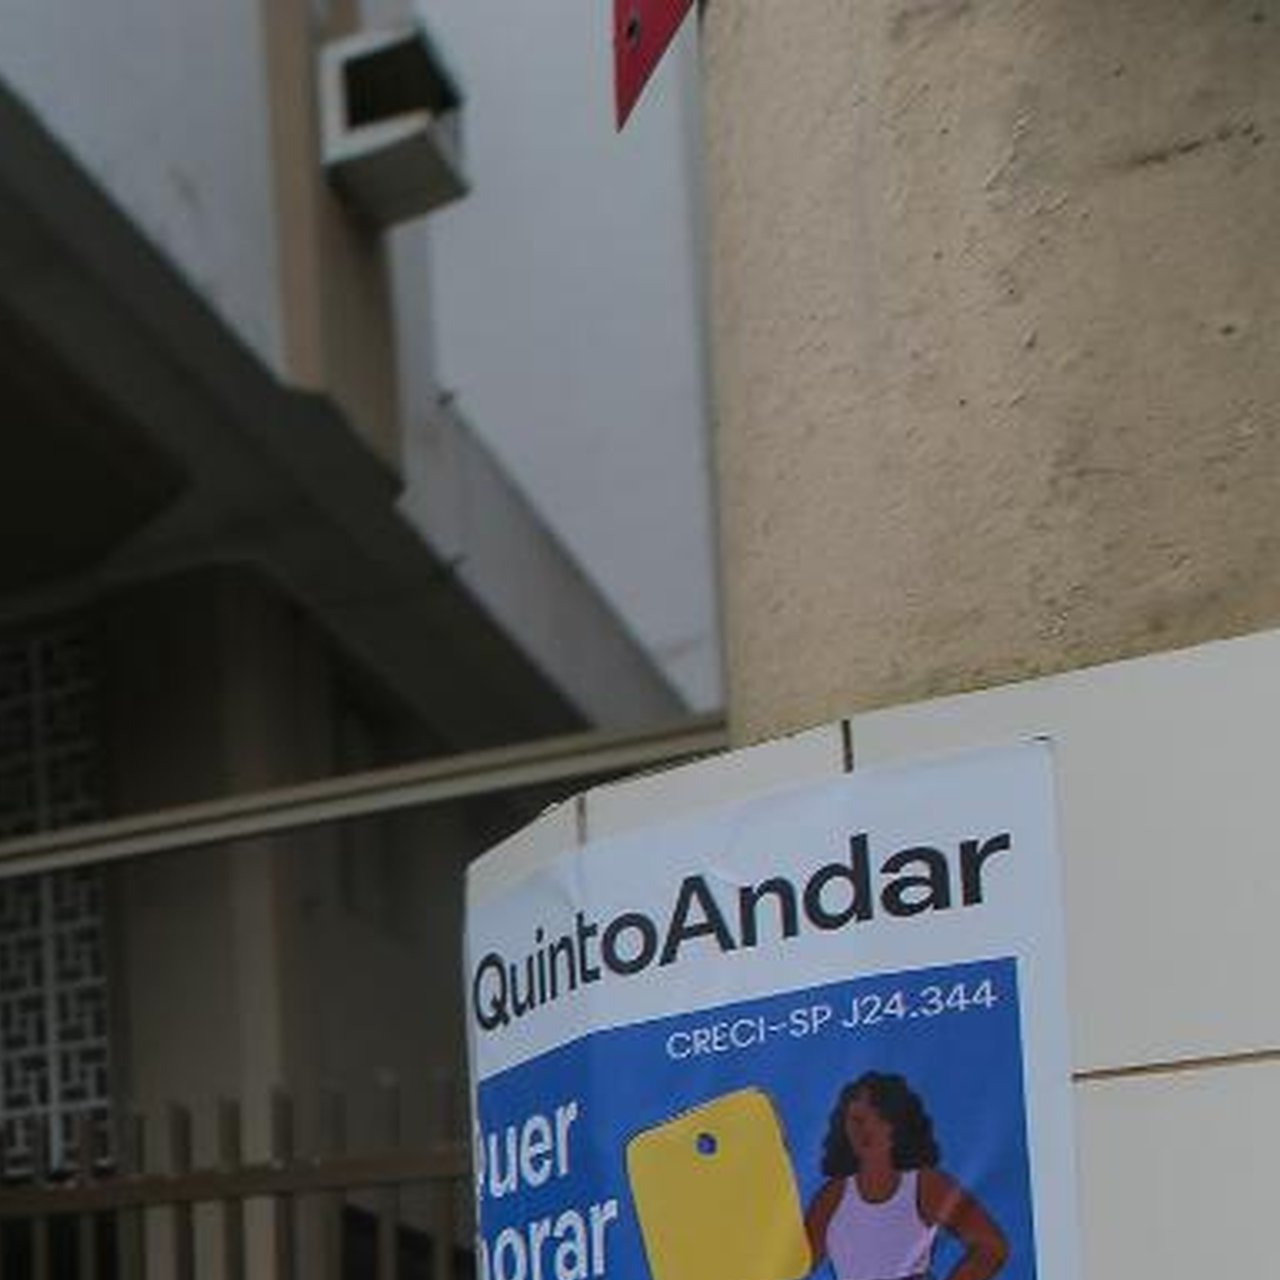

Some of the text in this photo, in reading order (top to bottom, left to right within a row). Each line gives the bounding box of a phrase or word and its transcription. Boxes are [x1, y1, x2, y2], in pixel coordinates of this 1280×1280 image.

[472, 833, 1011, 1032] QuintoAndar
[666, 979, 998, 1060] CRECI-SP J24.344
[478, 1101, 578, 1200] uer
